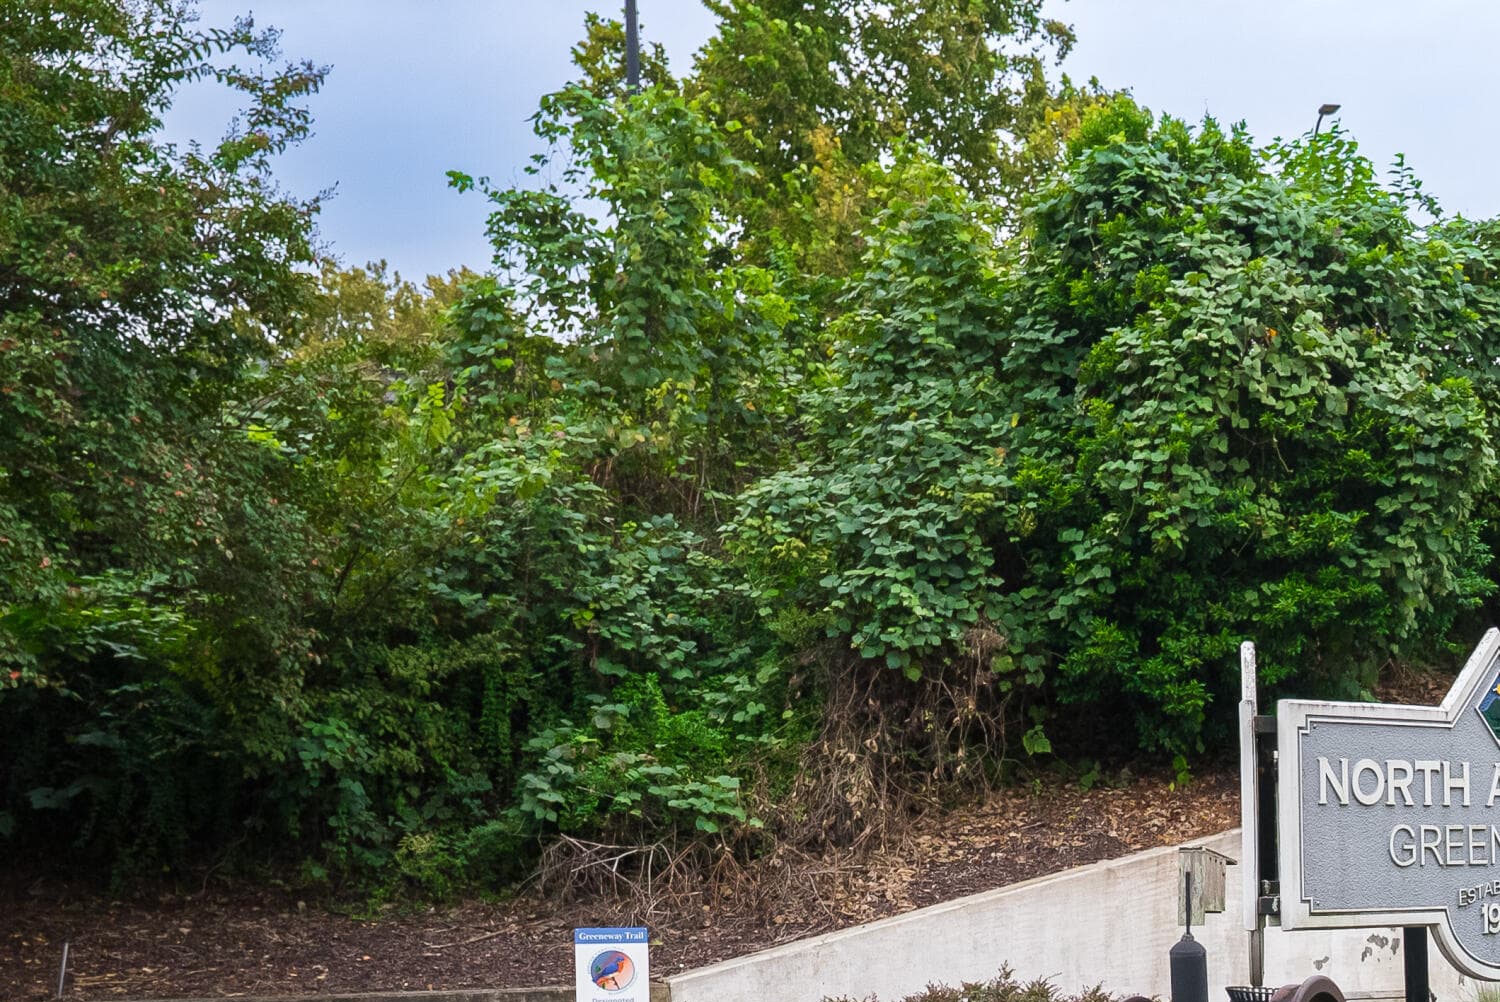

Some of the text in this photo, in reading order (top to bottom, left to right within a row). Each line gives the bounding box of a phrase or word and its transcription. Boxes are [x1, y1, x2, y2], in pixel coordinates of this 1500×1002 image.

[1317, 757, 1470, 807] NORTH
[579, 931, 644, 941] Greeneway Trail
